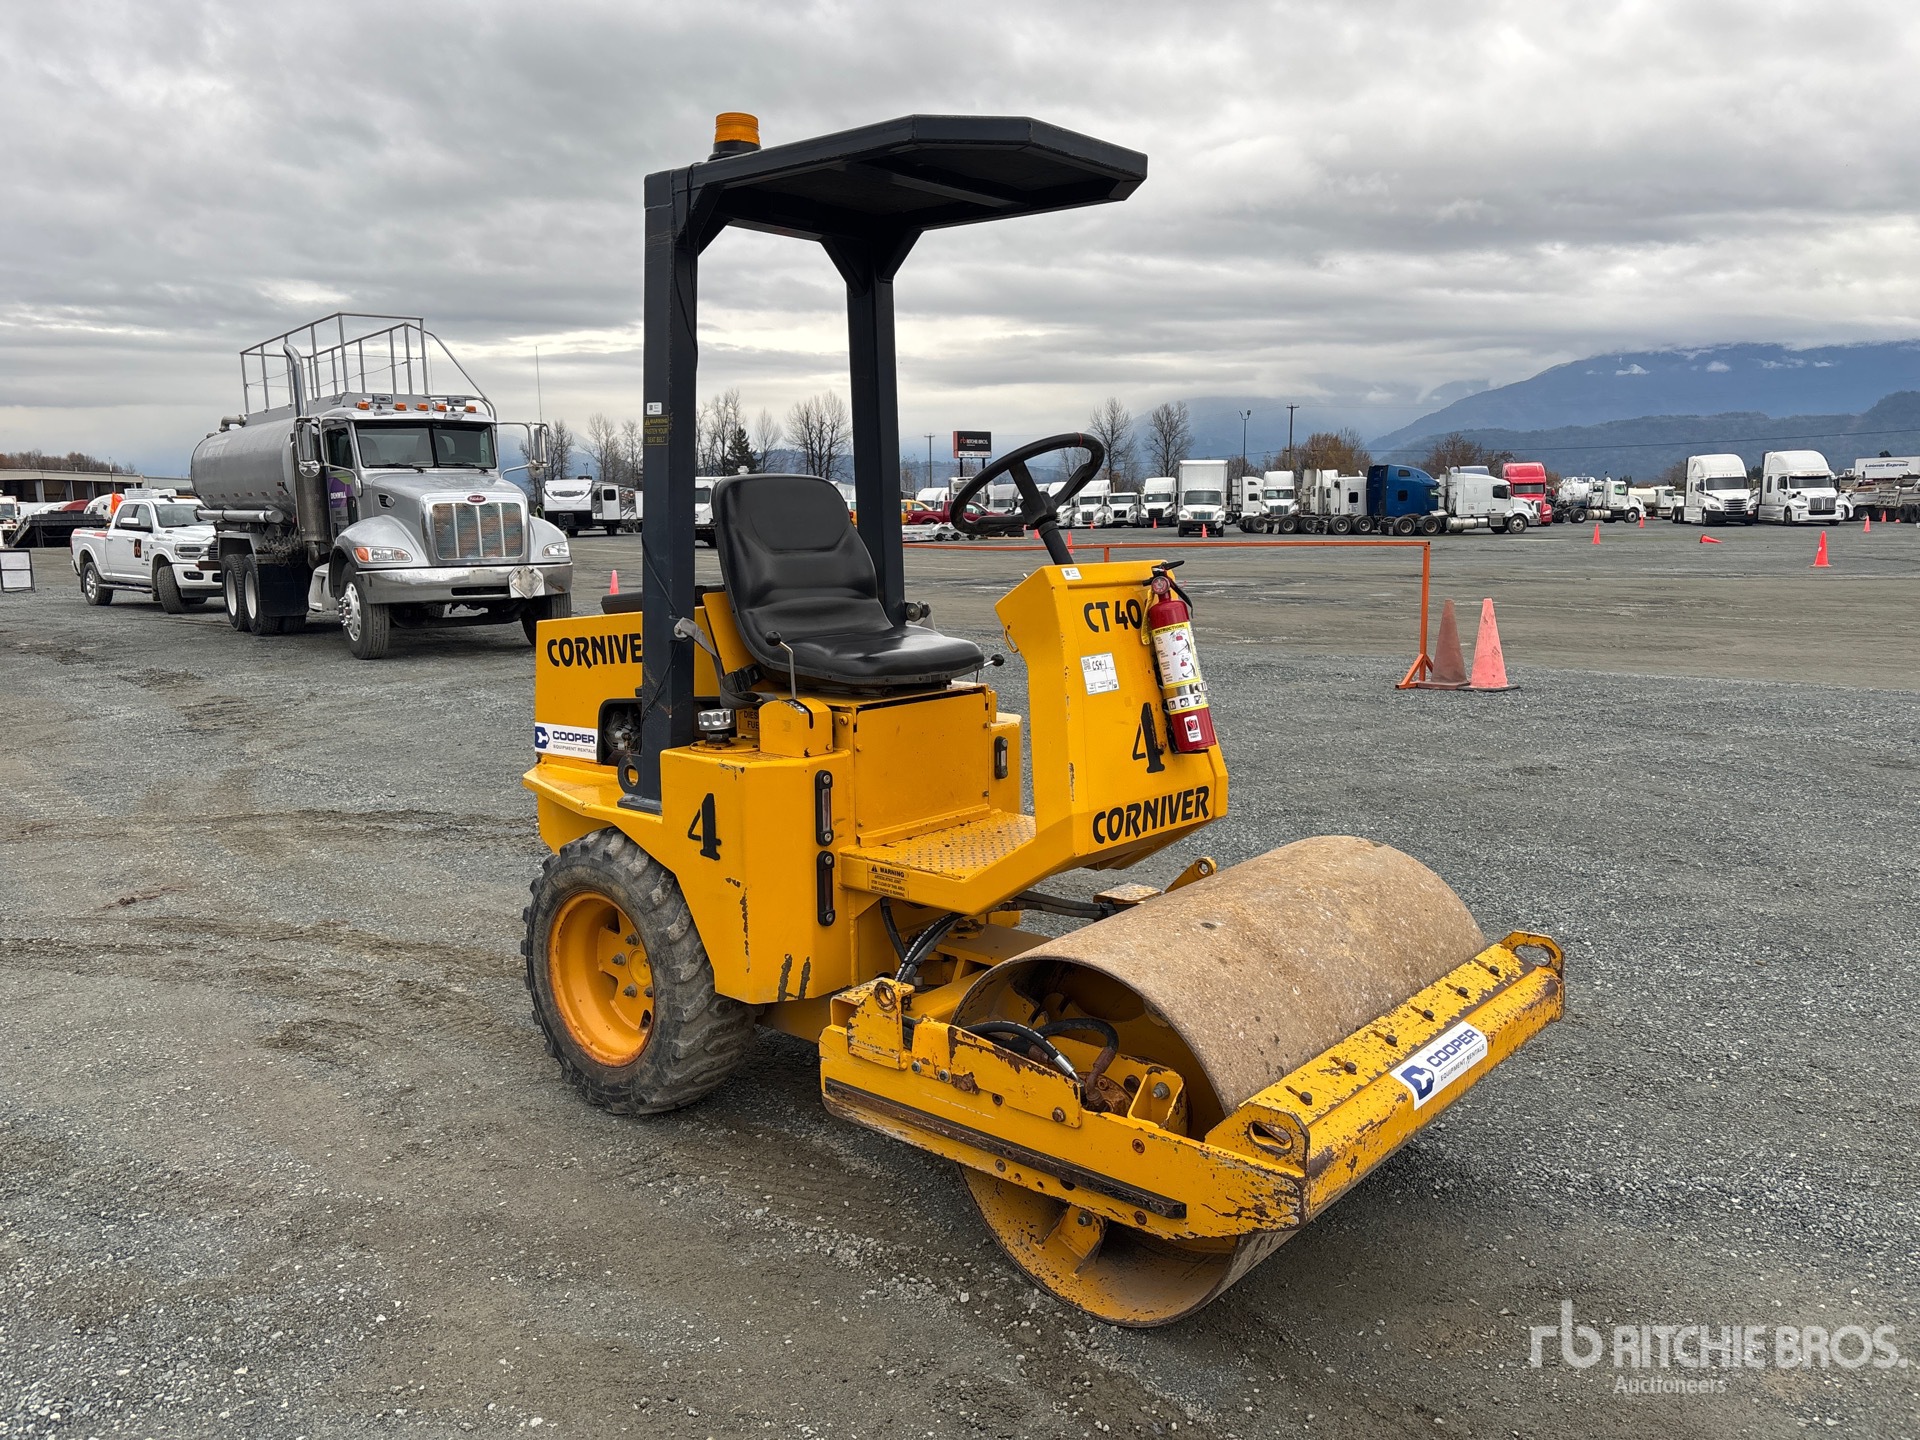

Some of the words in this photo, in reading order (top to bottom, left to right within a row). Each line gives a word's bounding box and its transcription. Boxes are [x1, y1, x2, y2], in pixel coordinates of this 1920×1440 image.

[1083, 601, 1110, 633] CT
[547, 633, 642, 669] CORNIVE
[743, 710, 759, 719] DIES
[747, 720, 759, 729] FUE
[552, 730, 595, 745] COOPER
[553, 744, 577, 752] EQUIPMENT
[1132, 702, 1165, 774] 4
[687, 792, 722, 861] 4
[1092, 785, 1210, 844] CORNIVER
[879, 867, 904, 878] WARNING
[1426, 1029, 1479, 1067] COOPER
[1440, 1057, 1466, 1081] EQUIPMENT
[1466, 1044, 1485, 1062] RENTALS
